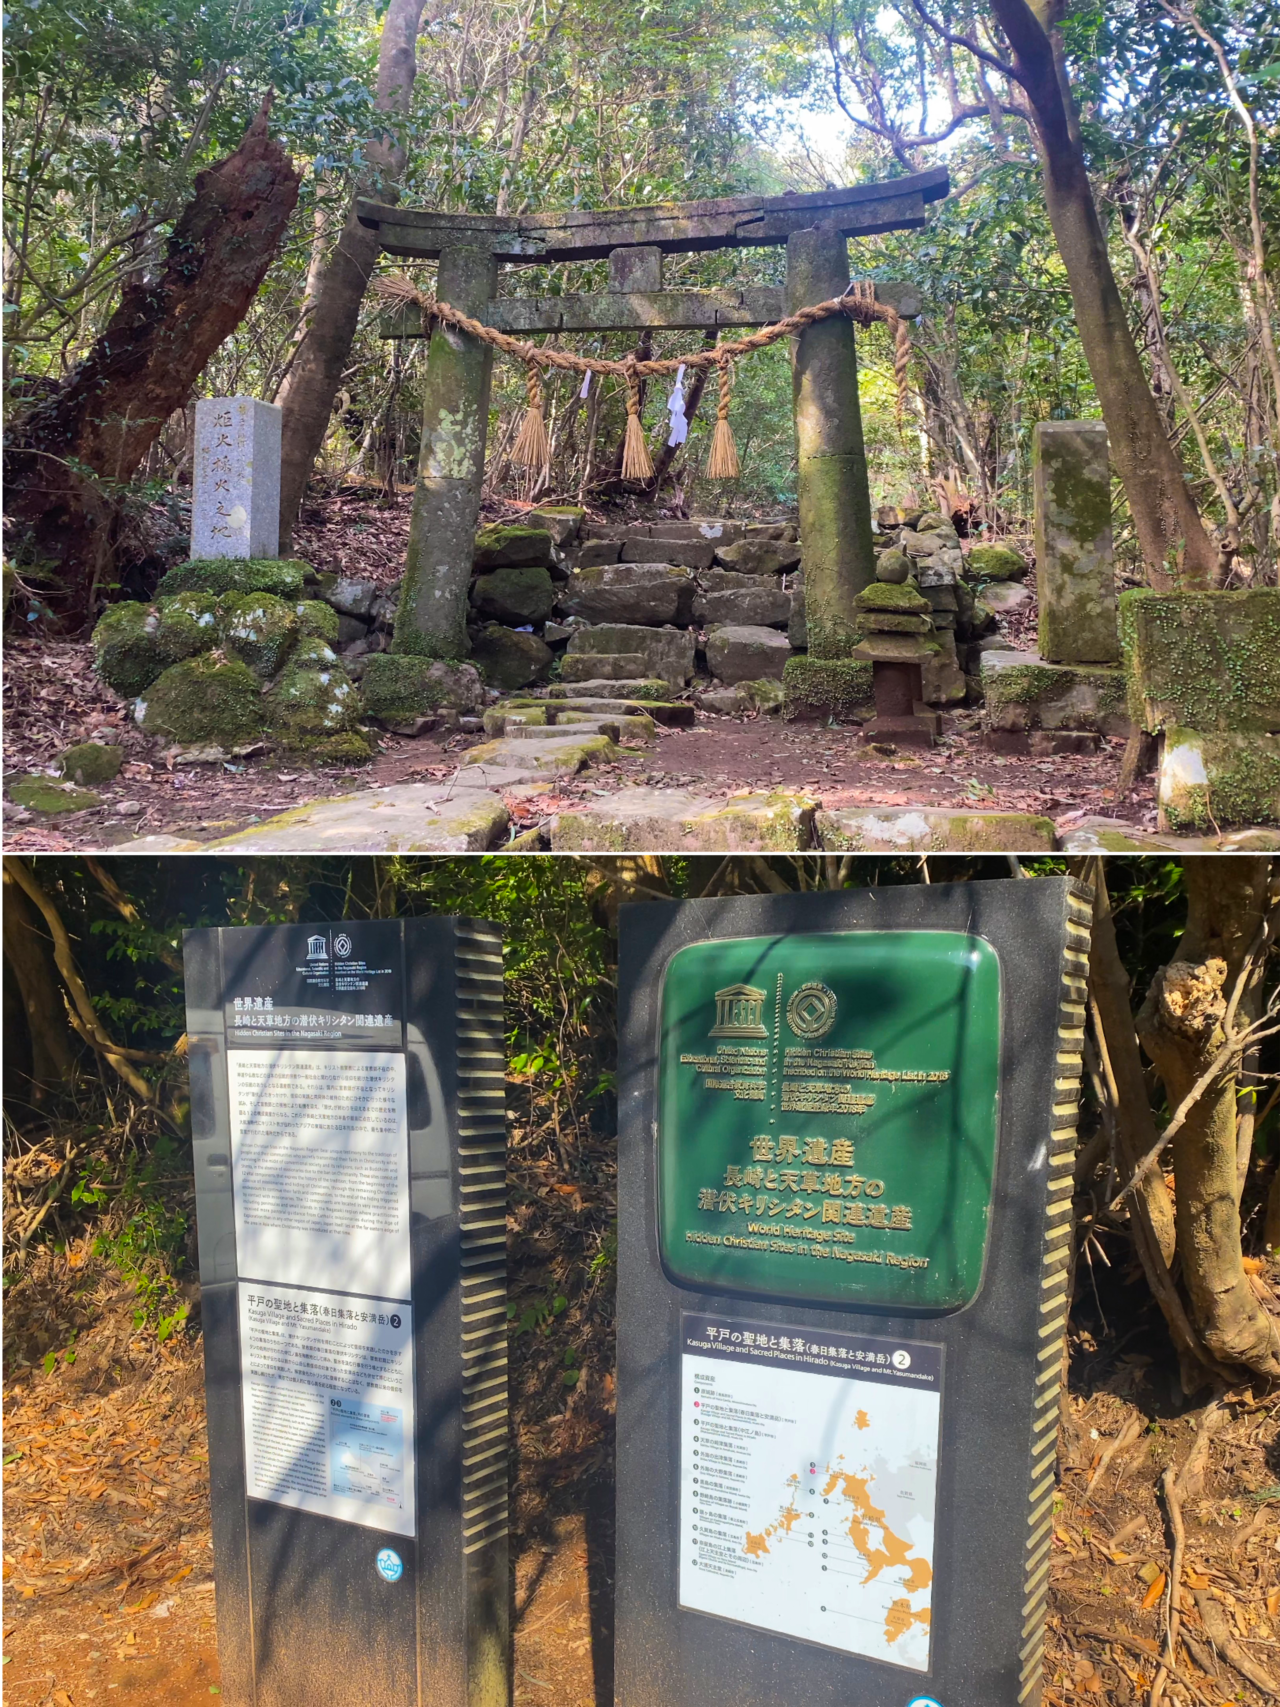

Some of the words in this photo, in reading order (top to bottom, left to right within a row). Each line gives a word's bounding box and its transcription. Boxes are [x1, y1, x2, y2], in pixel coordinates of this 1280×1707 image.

[233, 996, 274, 1011] 世界遺産
[234, 1014, 394, 1027] 長崎と天草地方の潜伏キリシタン関連遺産
[301, 1030, 323, 1038] Nagasaki
[324, 1031, 342, 1039] Region
[784, 1058, 791, 1066] in
[814, 1048, 851, 1058] Christian
[750, 1134, 854, 1168] 世界遺産
[723, 1165, 885, 1198] 長崎と天草地方の
[698, 1187, 912, 1231] 潜伏キリシタン関連遺産
[748, 1222, 781, 1236] World
[784, 1226, 831, 1243] Heritage
[833, 1231, 855, 1244] Site
[686, 1230, 720, 1246] Hidden
[723, 1235, 768, 1251] Christian
[770, 1240, 795, 1253] Sites
[798, 1243, 808, 1255] in
[810, 1244, 829, 1258] the
[832, 1247, 882, 1265] Nagasaki
[886, 1252, 930, 1269] Region
[248, 1308, 266, 1317] Kasuga
[267, 1310, 284, 1320] Village
[297, 1314, 314, 1323] Sacred
[315, 1317, 331, 1326] Places
[339, 1321, 357, 1330] Hirado
[266, 1318, 280, 1326] Village
[687, 1338, 712, 1349] Kasuga
[712, 1341, 735, 1353] Village
[735, 1344, 748, 1354] and
[750, 1347, 772, 1358] Sacred
[774, 1350, 795, 1360] Places
[796, 1353, 803, 1361] in
[804, 1355, 828, 1365] Hirado
[830, 1360, 851, 1370] (Kasuga
[852, 1363, 870, 1372] Village
[871, 1366, 882, 1374] and
